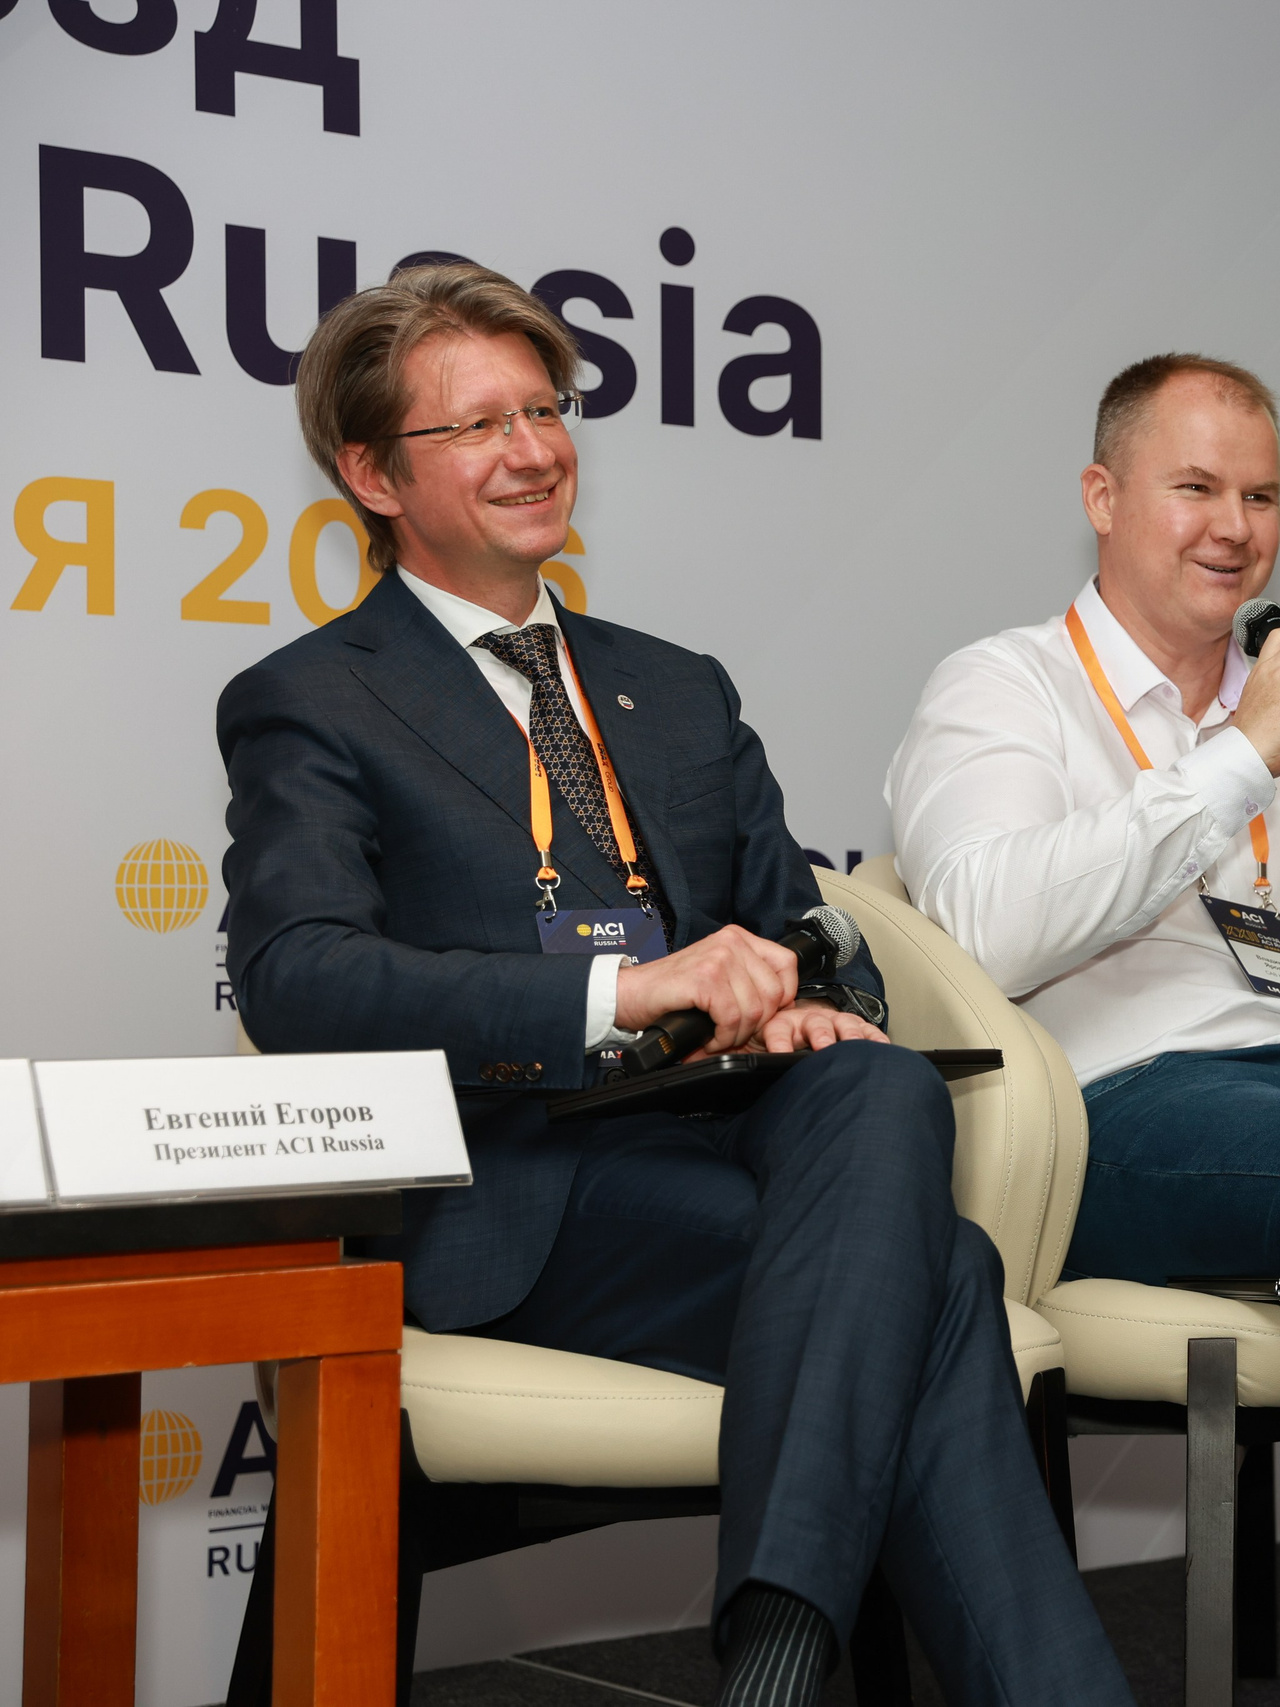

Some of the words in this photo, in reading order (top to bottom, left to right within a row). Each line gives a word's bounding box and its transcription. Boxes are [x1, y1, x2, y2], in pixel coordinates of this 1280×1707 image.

[39, 144, 823, 442] Rusia
[592, 922, 625, 937] ACI
[143, 1103, 267, 1131] Евгений
[273, 1102, 374, 1130] Егоров
[153, 1142, 267, 1165] Президент
[320, 1133, 386, 1154] Russia
